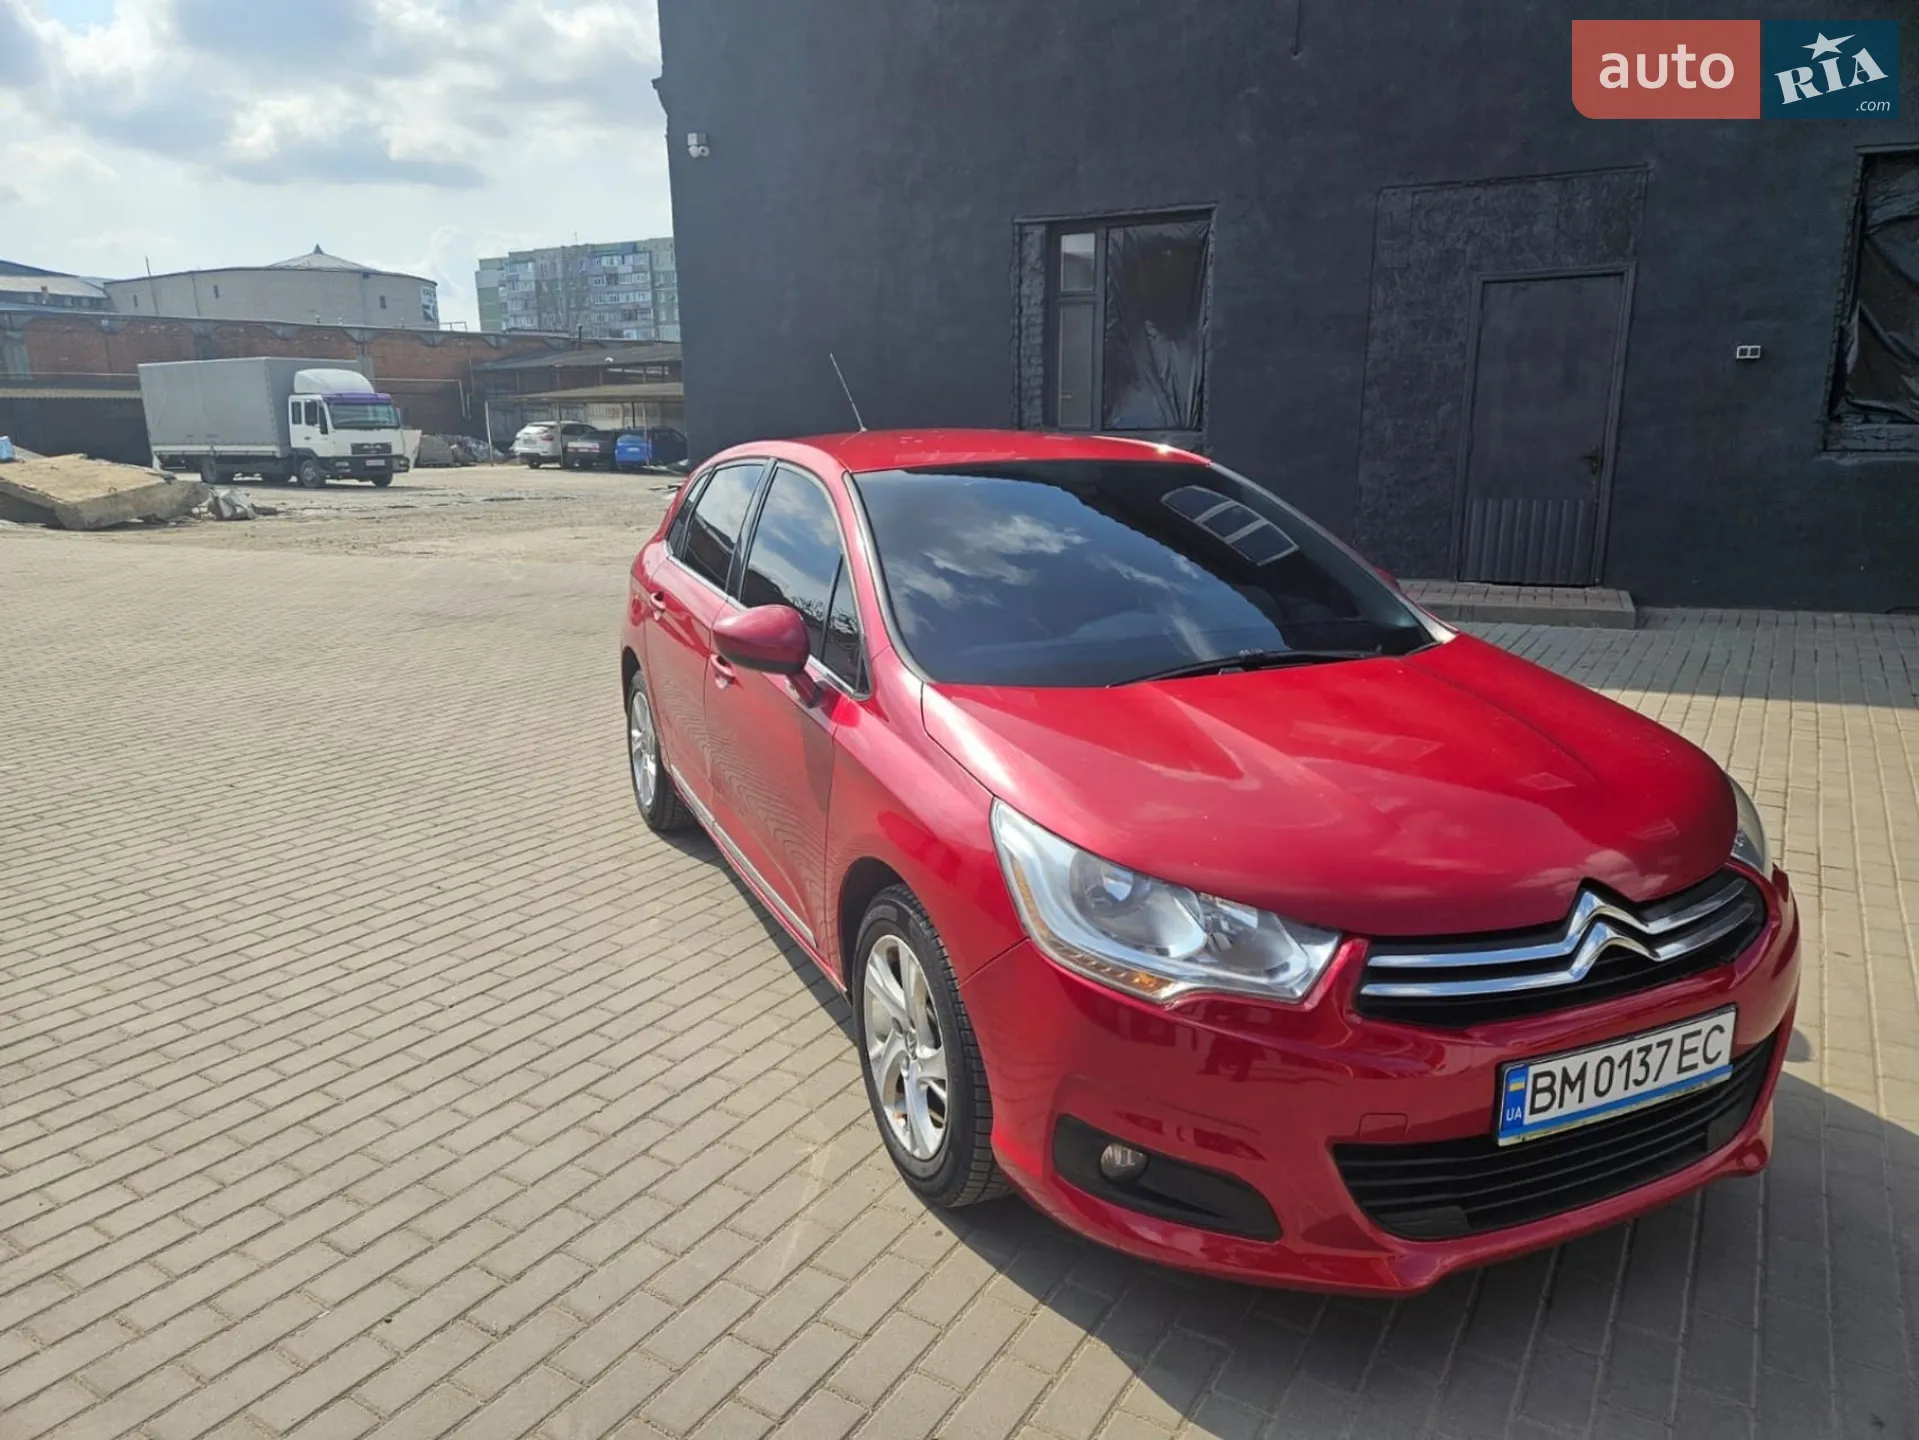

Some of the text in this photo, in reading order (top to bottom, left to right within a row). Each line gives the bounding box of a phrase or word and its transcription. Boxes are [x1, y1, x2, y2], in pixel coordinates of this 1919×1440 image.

[1529, 1023, 1726, 1115] BM 0137 EC
[1506, 1106, 1522, 1121] UA
